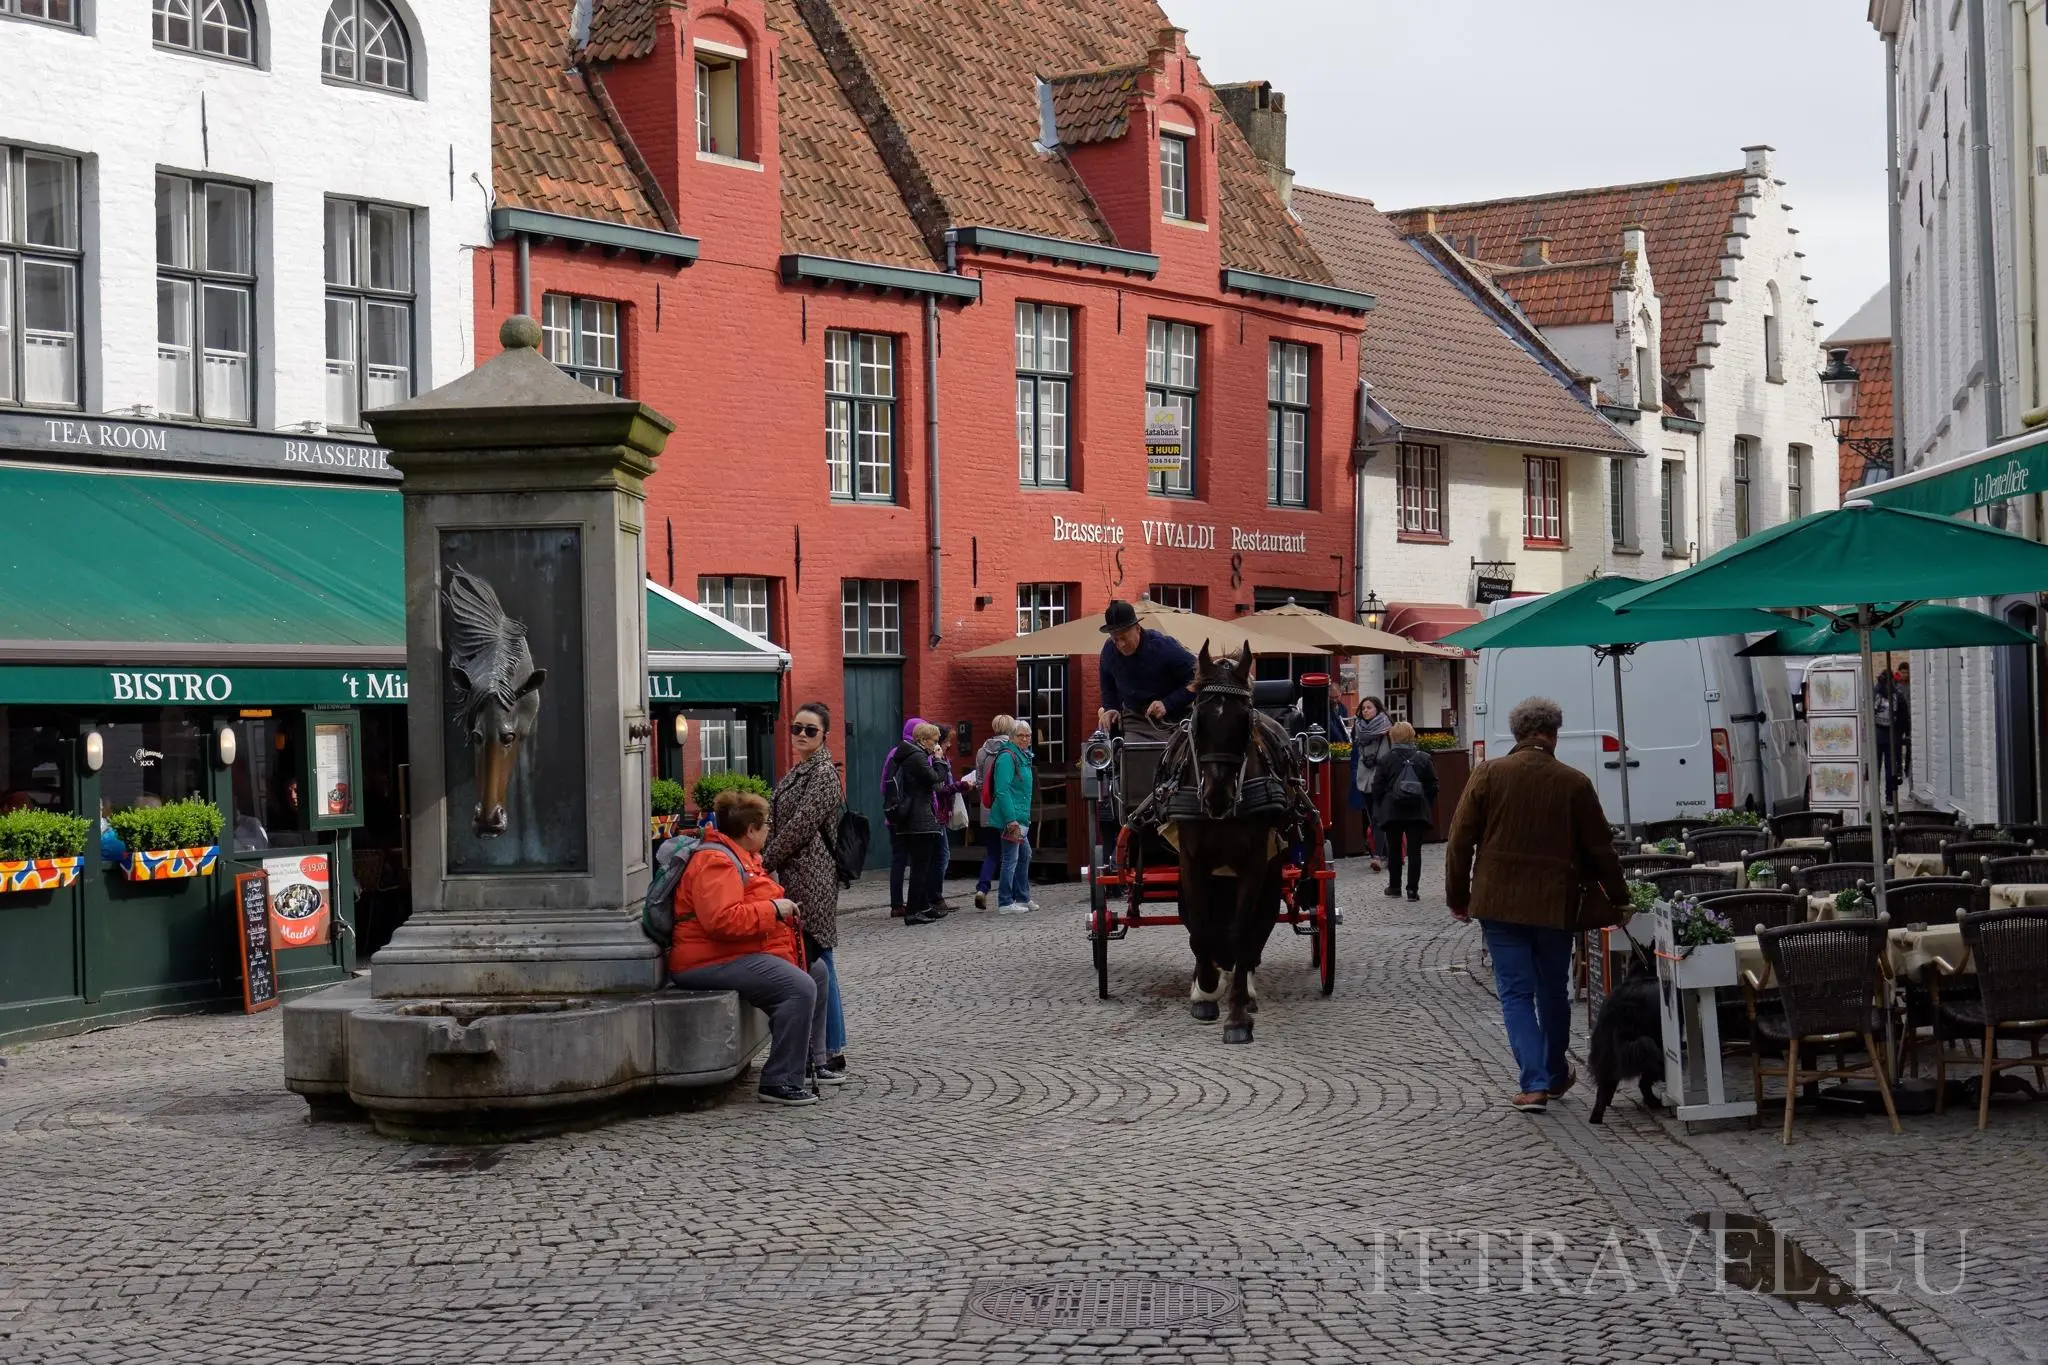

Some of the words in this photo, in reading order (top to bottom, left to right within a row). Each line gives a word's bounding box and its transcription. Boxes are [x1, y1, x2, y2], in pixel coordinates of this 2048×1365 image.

[45, 420, 93, 445] TEA
[98, 424, 167, 451] ROOM
[284, 441, 390, 470] BRASSERIE
[1156, 446, 1180, 454] HUUR
[1974, 477, 1983, 505] La
[1053, 515, 1124, 544] Brasserie
[1142, 520, 1216, 550] VIVALDI
[1231, 526, 1306, 553] Restaurant
[111, 673, 232, 701] BISTRO
